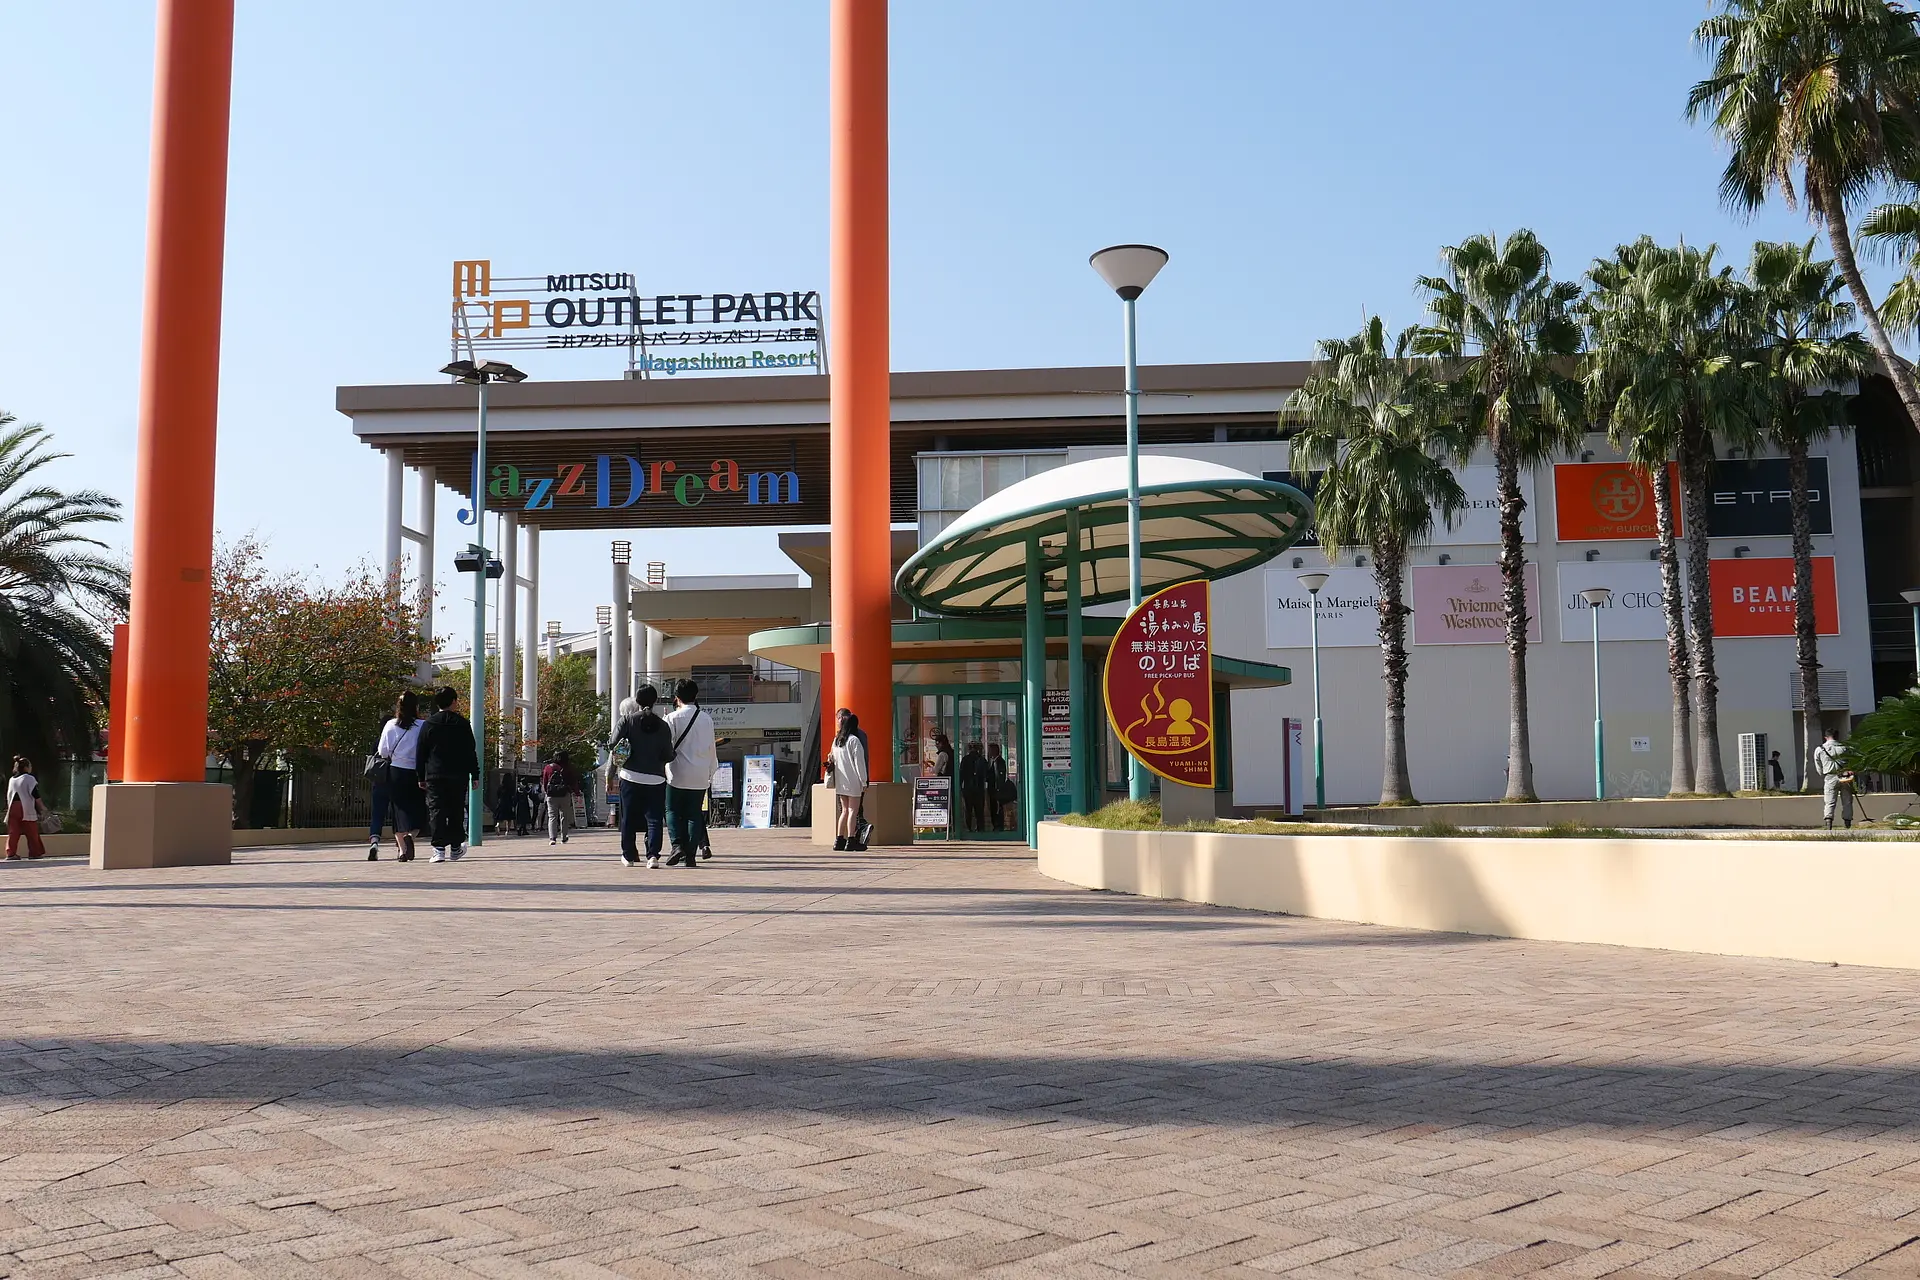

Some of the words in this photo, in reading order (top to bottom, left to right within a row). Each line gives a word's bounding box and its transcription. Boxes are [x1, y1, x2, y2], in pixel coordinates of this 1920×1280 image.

[546, 272, 629, 292] MITSUI
[545, 294, 702, 329] OUTLET
[712, 290, 818, 323] PARK
[546, 331, 691, 349] 三井アウトレットパーク
[698, 327, 818, 345] ジャズドリーム長島
[640, 352, 747, 376] Nagashima
[752, 349, 818, 368] Resort
[1616, 524, 1657, 533] BURCH
[1326, 596, 1380, 610] Margiela
[1622, 591, 1665, 609] CHO
[1732, 585, 1796, 603] BEAM
[1446, 597, 1505, 613] Vivienne
[1749, 605, 1792, 613] OUTLE
[1139, 610, 1207, 638] 湯あみの島
[1440, 613, 1506, 630] Westwoo
[1131, 640, 1208, 653] 無料送迎バス
[1138, 653, 1201, 671] のりば
[1145, 736, 1192, 747] 長島温泉
